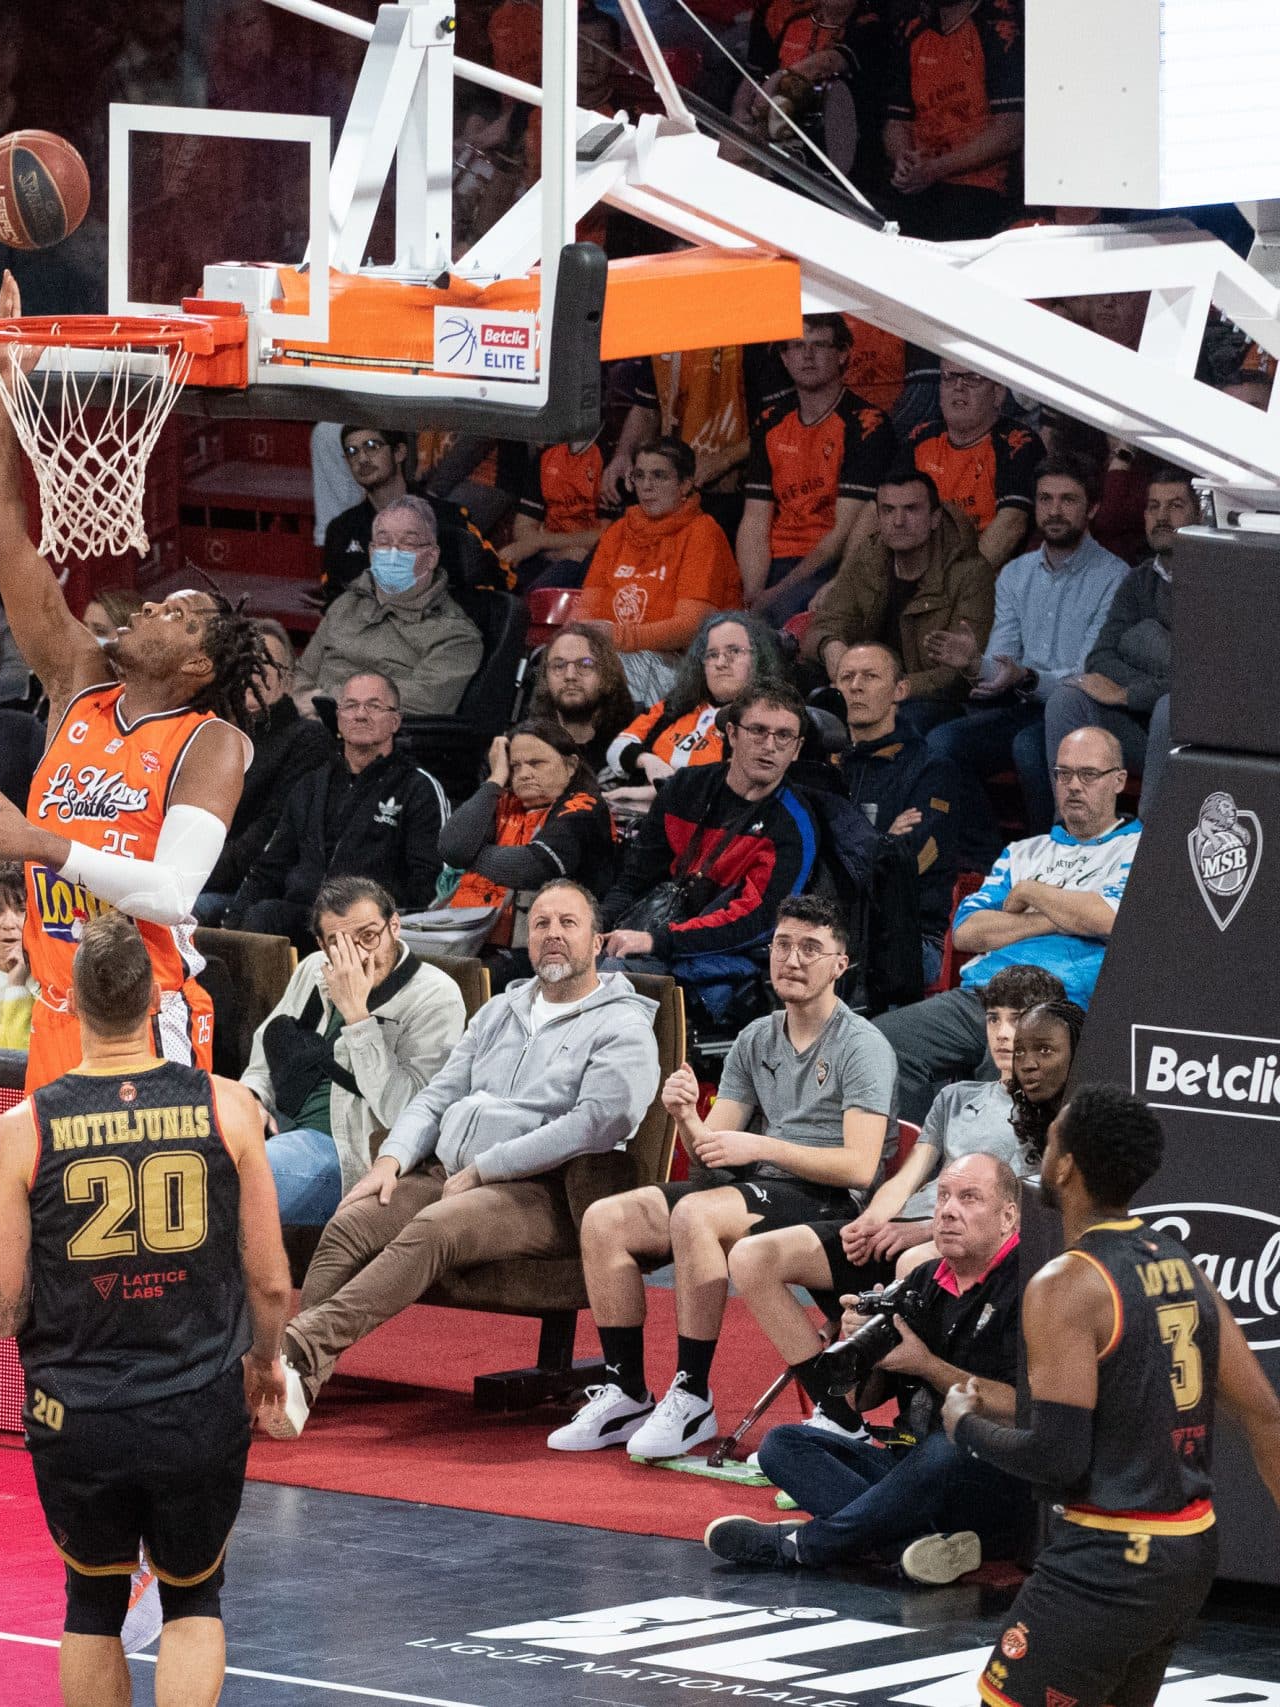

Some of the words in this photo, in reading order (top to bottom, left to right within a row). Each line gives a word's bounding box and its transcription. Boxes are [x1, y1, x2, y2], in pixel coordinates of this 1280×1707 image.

[483, 328, 526, 346] Betclic
[483, 349, 526, 371] ÉLITE
[78, 765, 150, 812] Mans
[57, 788, 119, 823] Sarthe
[373, 814, 398, 827] adidas
[1203, 846, 1247, 878] MSB
[198, 1015, 212, 1045] 25
[50, 1105, 212, 1151] MOTIEJUNAS
[63, 1150, 208, 1261] 20
[122, 1269, 188, 1287] LATTICE
[122, 1285, 165, 1300] LABS
[1156, 1300, 1203, 1412] 3
[32, 1388, 65, 1432] 20
[1124, 1532, 1152, 1565] 3
[405, 1636, 566, 1666] LIGUE
[562, 1661, 860, 1707] NATIONALE
